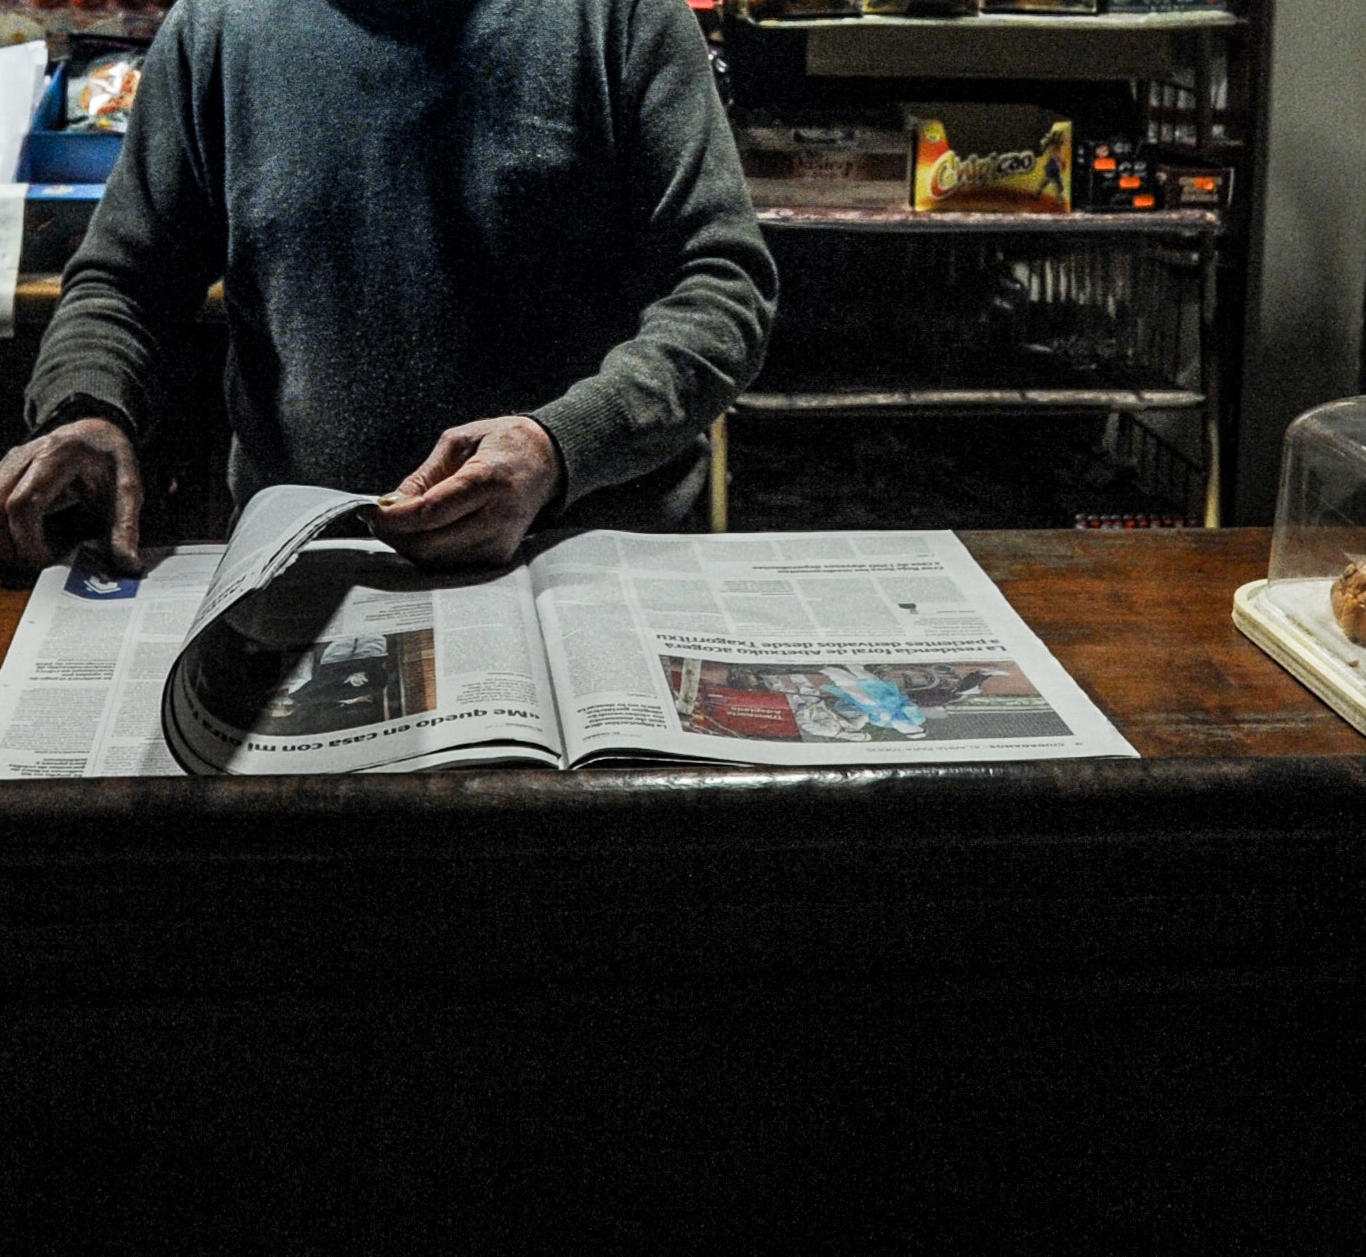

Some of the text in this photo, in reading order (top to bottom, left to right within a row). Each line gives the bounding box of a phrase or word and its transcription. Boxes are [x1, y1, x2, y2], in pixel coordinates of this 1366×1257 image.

[655, 633, 757, 649] Txagorritxu
[760, 641, 813, 650] desde
[816, 641, 902, 650] derivados
[904, 638, 986, 649] pacientes
[663, 642, 1008, 657] La residencia foral de Abetxuko acogerá
[416, 709, 488, 729] quedo
[383, 725, 411, 737] en
[329, 732, 378, 748] casa
[247, 742, 277, 753] mi
[282, 742, 324, 753] con
